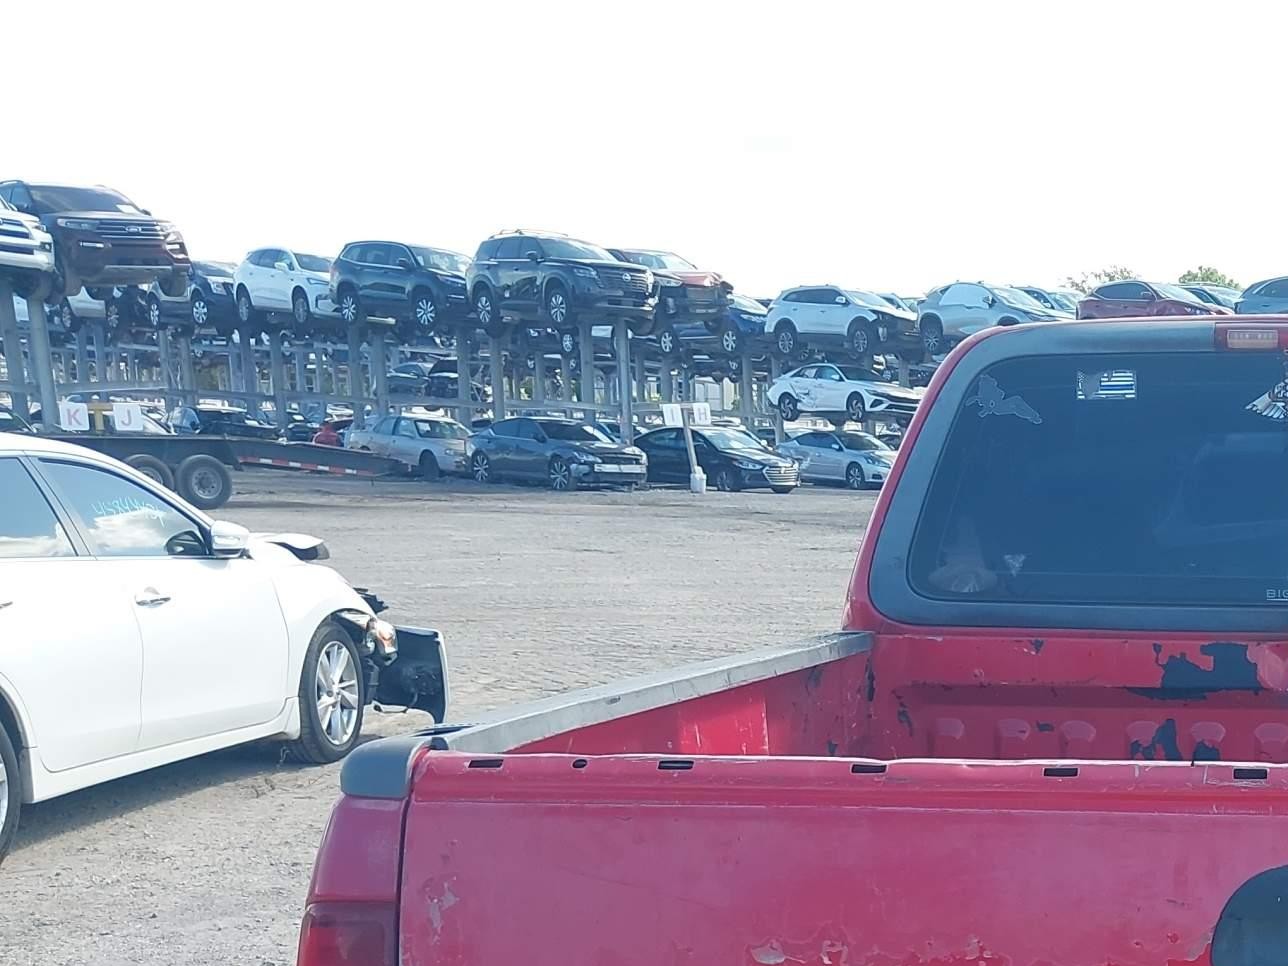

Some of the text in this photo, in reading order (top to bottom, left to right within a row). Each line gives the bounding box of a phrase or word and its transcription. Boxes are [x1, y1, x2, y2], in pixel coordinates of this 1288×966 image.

[66, 408, 82, 426] K
[121, 409, 132, 426] J
[697, 407, 708, 421] H
